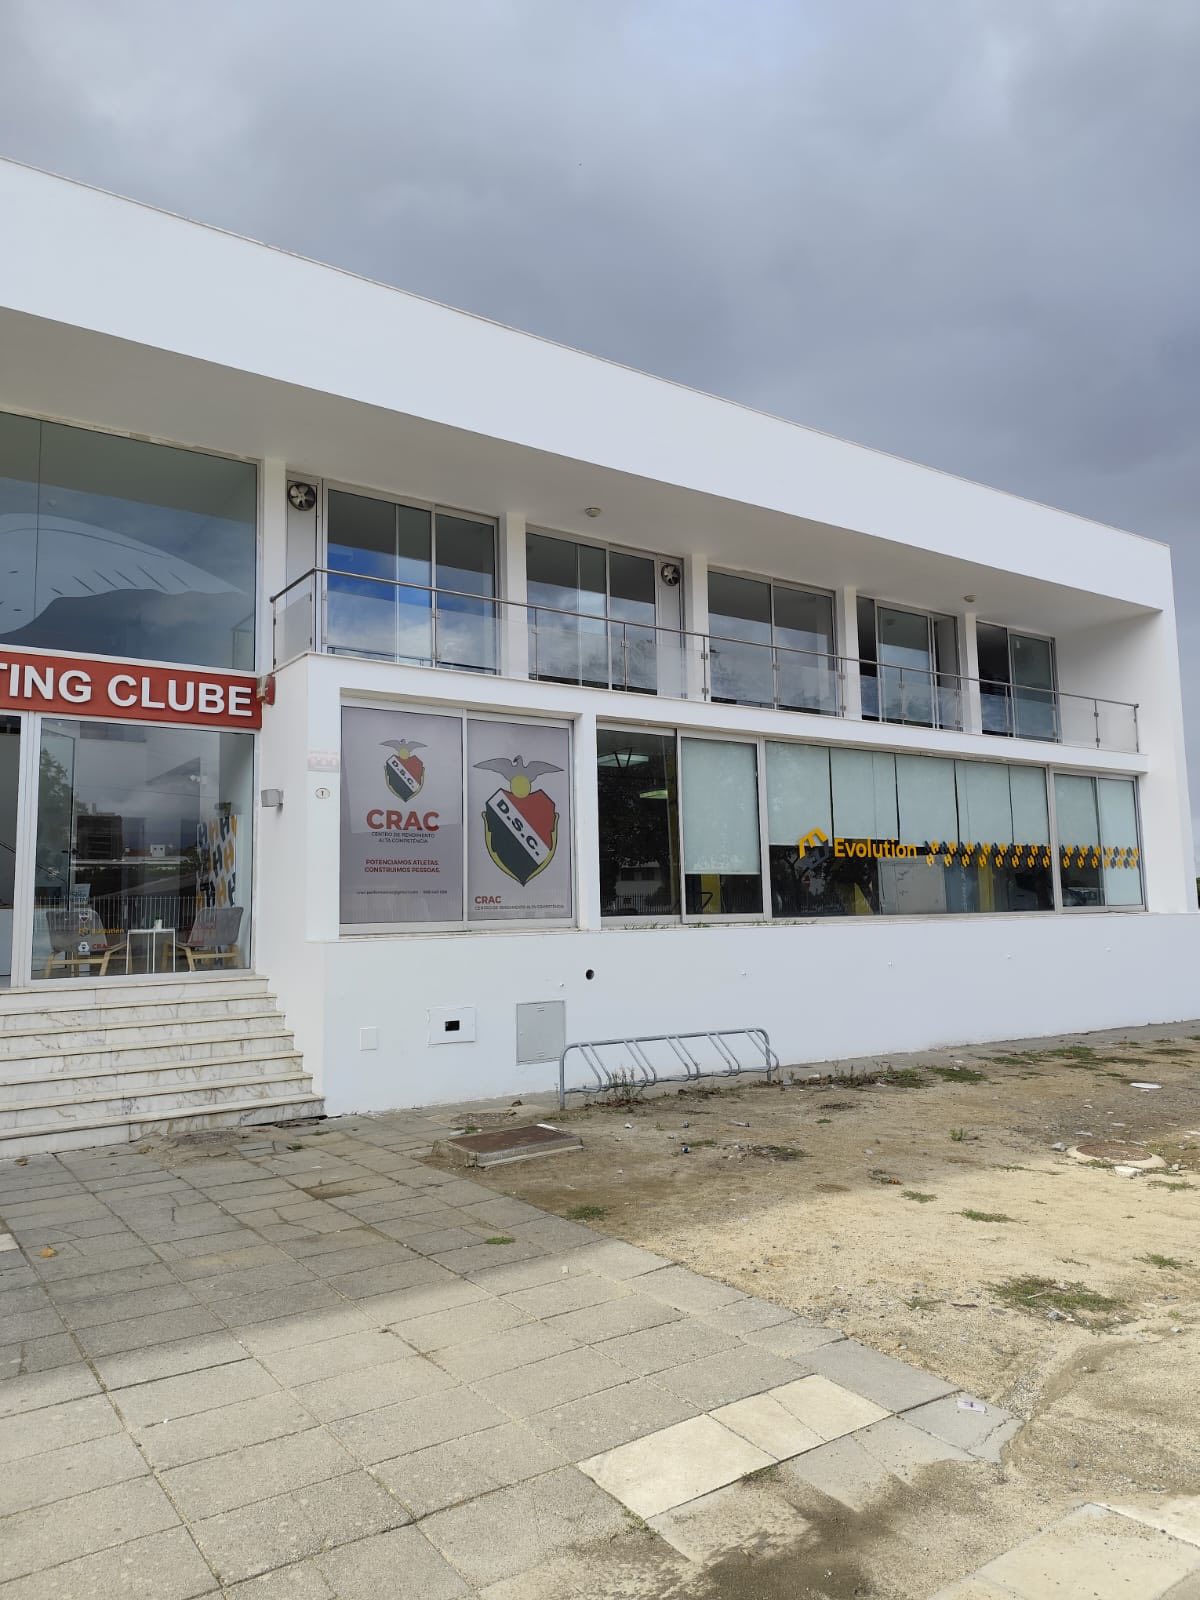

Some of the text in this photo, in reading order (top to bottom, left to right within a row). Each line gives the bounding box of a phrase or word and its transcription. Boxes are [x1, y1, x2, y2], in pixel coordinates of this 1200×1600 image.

[107, 674, 253, 717] CLUBE
[366, 809, 440, 832] CRAC
[834, 838, 918, 859] Evolution
[474, 896, 502, 904] CRAC
